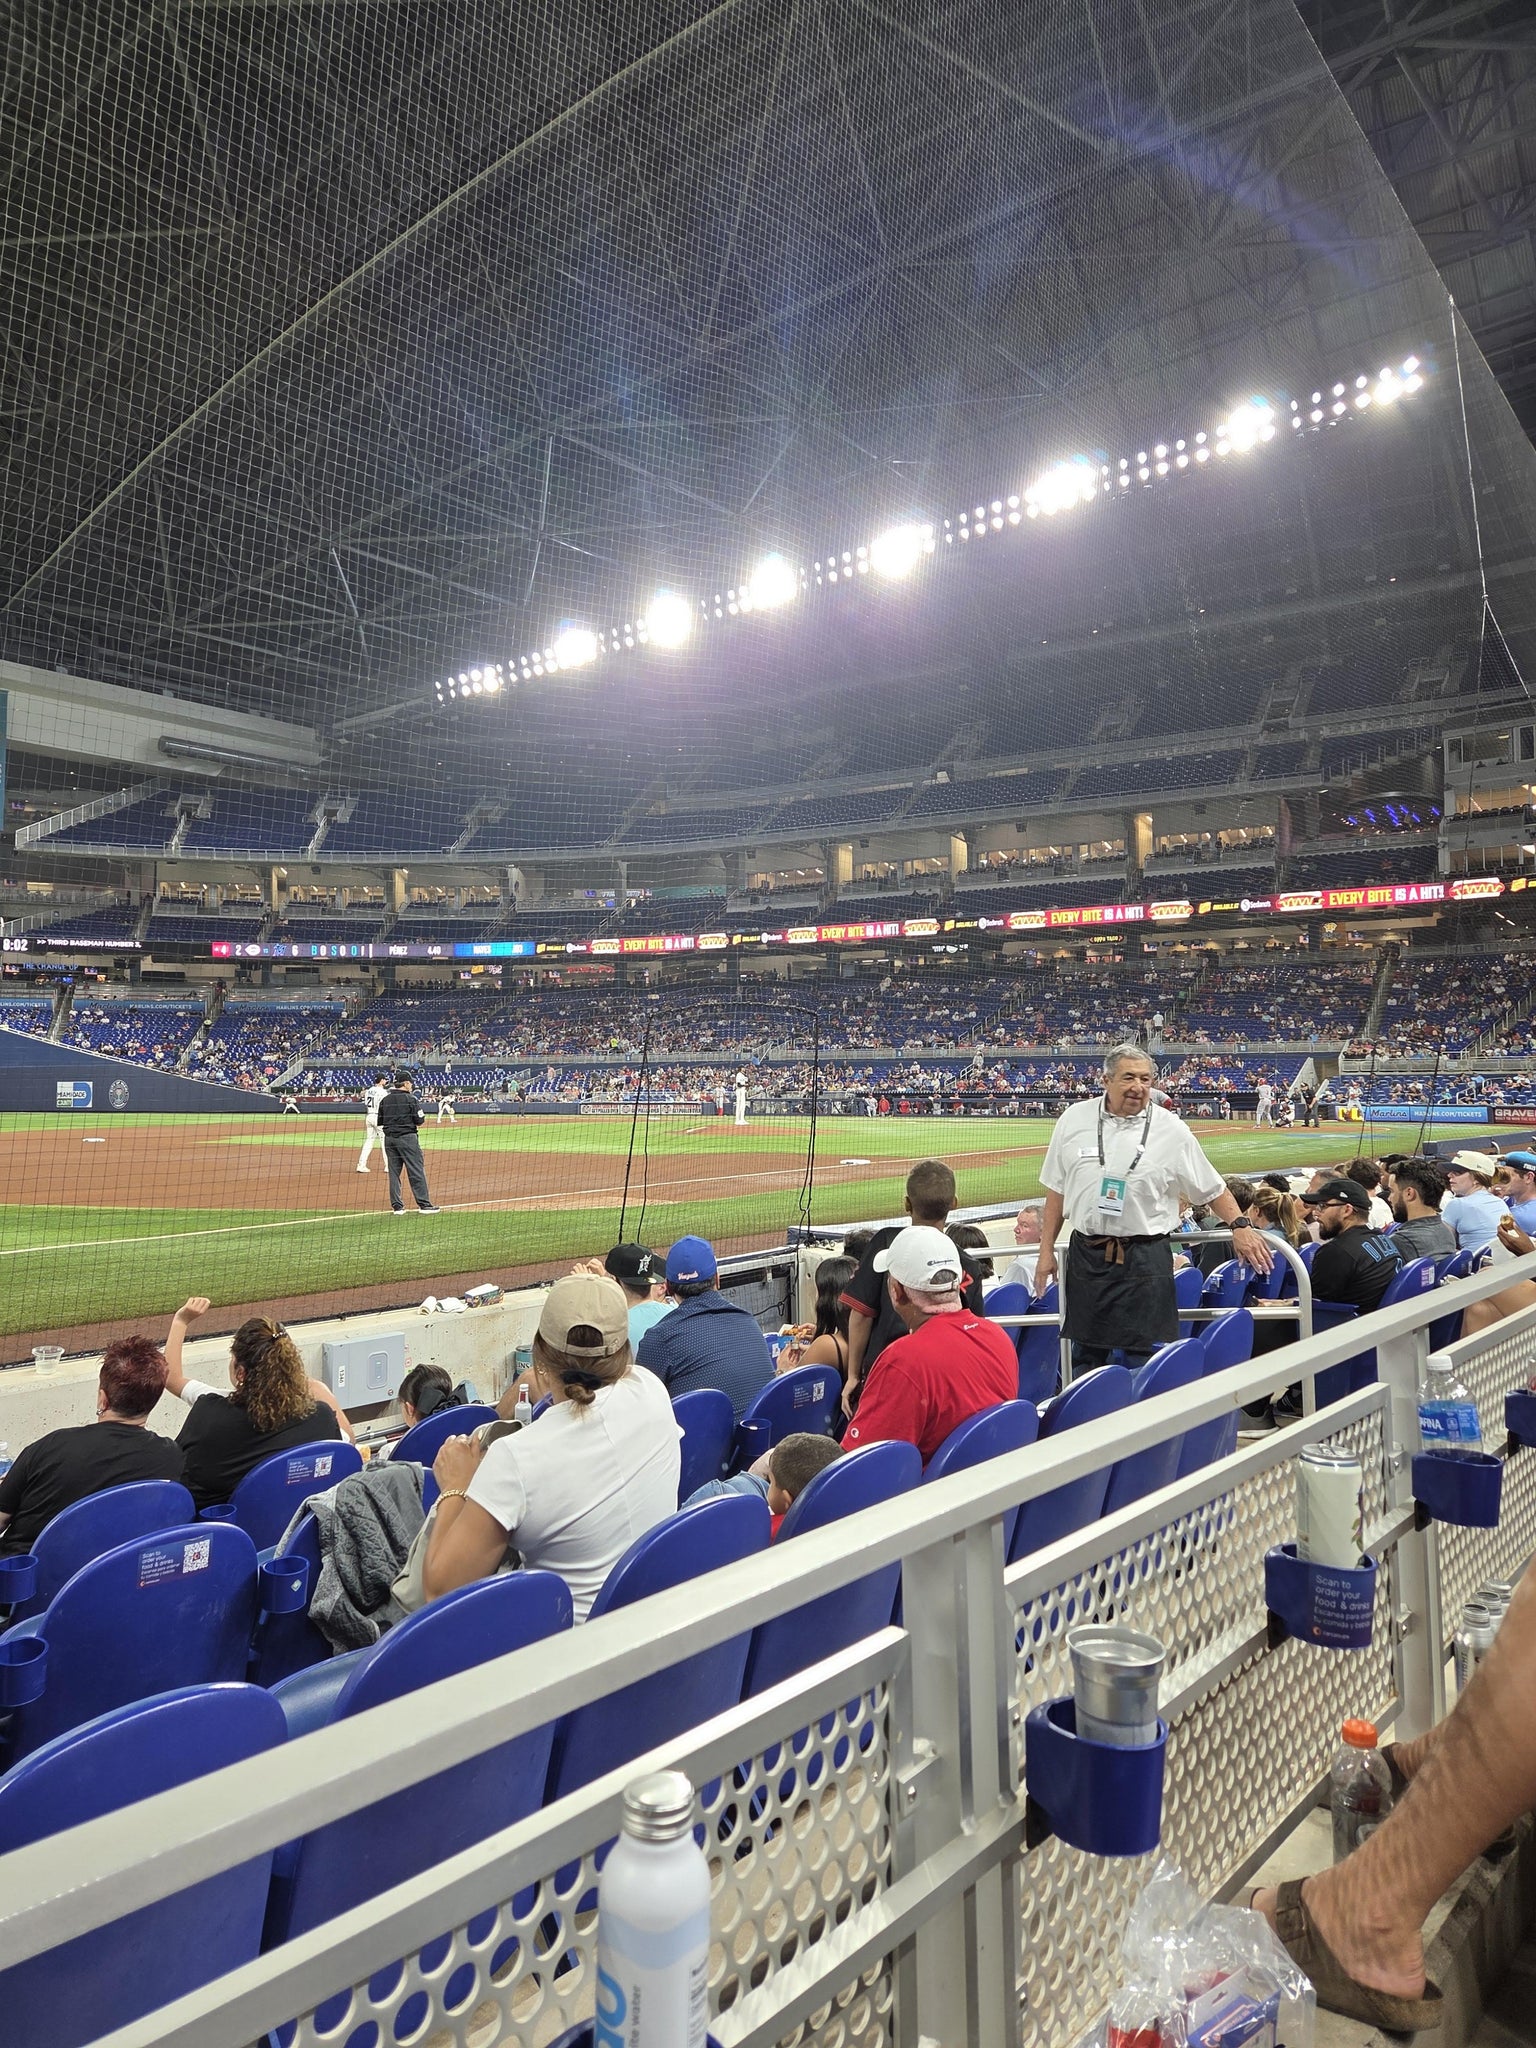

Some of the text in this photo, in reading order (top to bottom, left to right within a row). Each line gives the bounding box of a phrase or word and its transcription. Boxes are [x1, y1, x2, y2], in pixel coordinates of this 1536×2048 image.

[1329, 891, 1365, 906] EVERY
[1367, 889, 1393, 904] BITE
[1394, 887, 1407, 901] IS
[1409, 886, 1419, 901] A
[1050, 911, 1080, 924] EVERY
[1082, 909, 1103, 922] BITE
[1104, 908, 1114, 921] IS
[1115, 907, 1124, 920] A
[821, 927, 846, 939] EVERY
[847, 926, 865, 937] BITE
[875, 924, 882, 936] A
[2, 938, 28, 951] 8:02
[235, 944, 242, 956] 2
[292, 944, 299, 956] 6
[623, 940, 647, 951] EVERY
[648, 939, 664, 950] BITE
[674, 937, 680, 949] A
[1371, 1109, 1407, 1118] Marlins
[1494, 1108, 1536, 1117] GRAVE
[1315, 1574, 1352, 1590] Scan to
[1315, 1585, 1361, 1601] order your
[1314, 1595, 1337, 1609] food
[1340, 1600, 1348, 1610] &
[1313, 1606, 1345, 1620] Escanea
